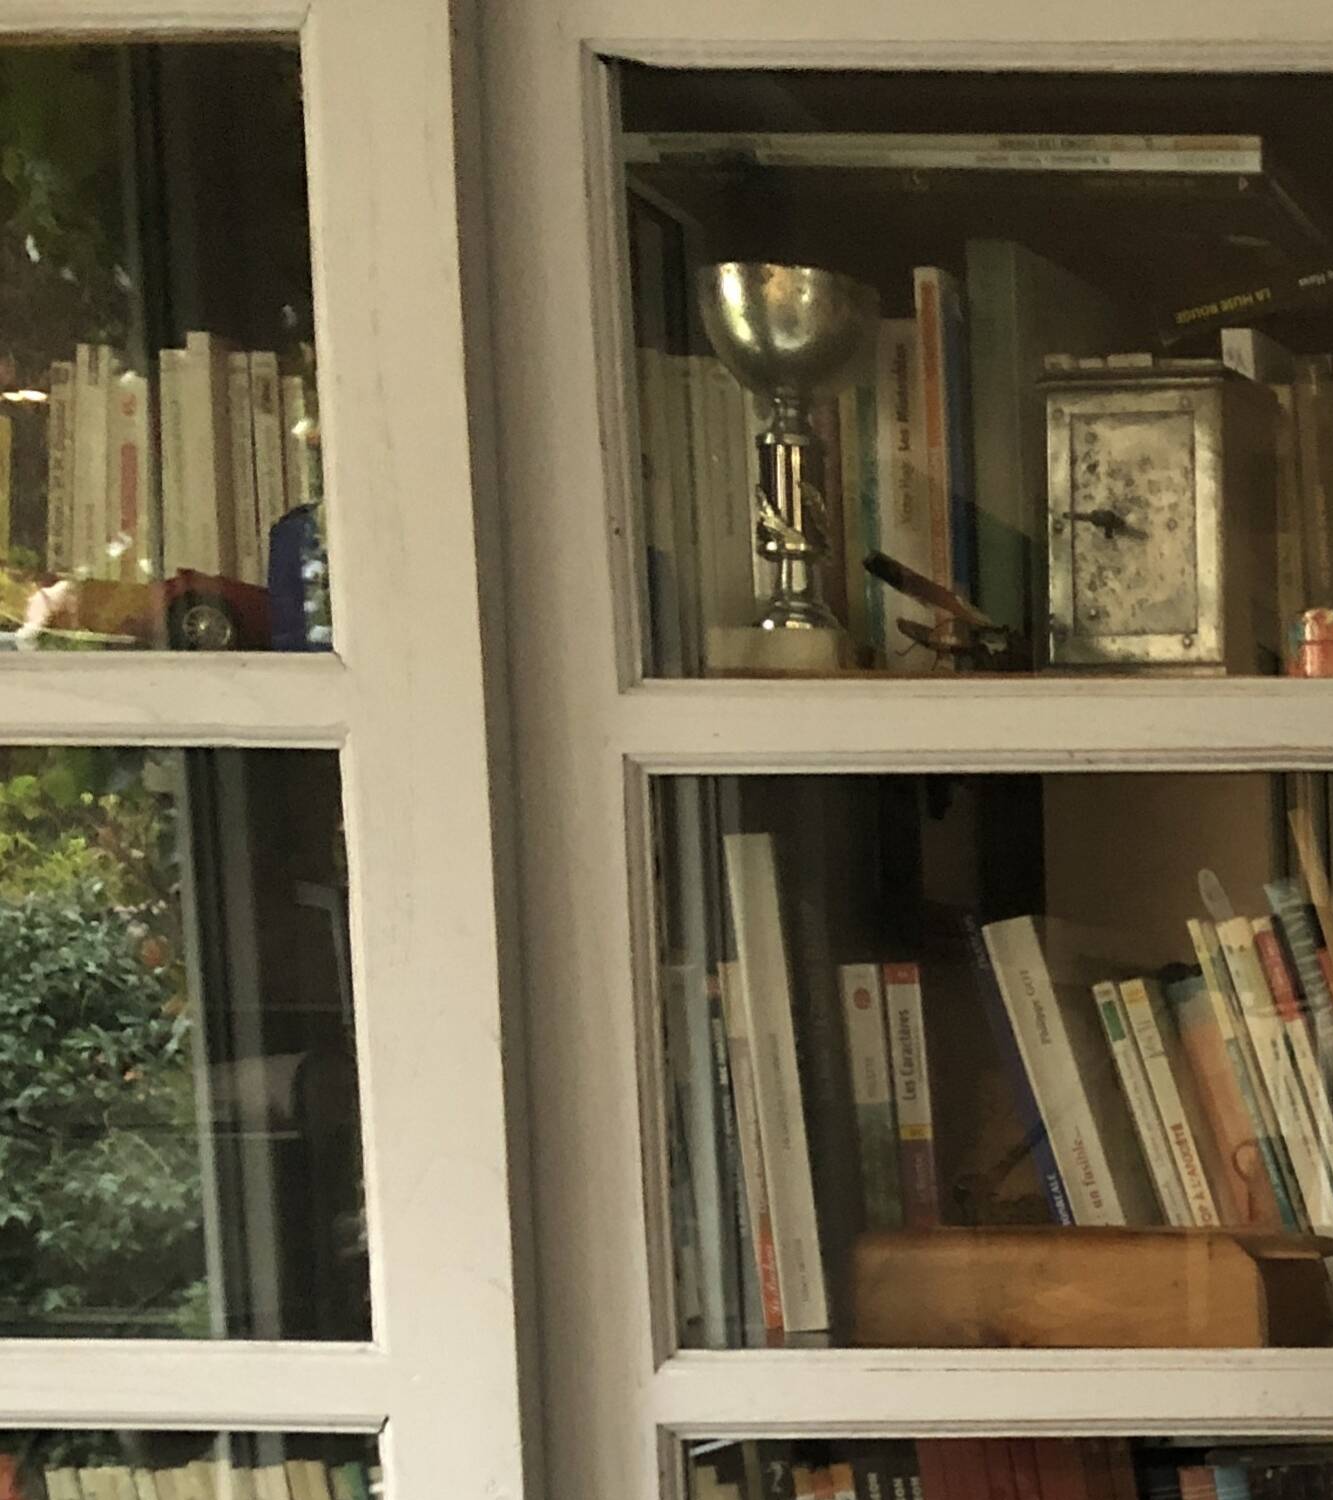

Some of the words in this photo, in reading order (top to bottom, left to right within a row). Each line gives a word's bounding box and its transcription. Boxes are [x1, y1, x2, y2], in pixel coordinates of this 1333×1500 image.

[1175, 301, 1219, 326] ROUGE
[895, 429, 911, 452] Les
[1026, 997, 1054, 1047] Philippe
[892, 1008, 918, 1076] Caractères
[899, 1079, 918, 1102] Les
[1083, 1188, 1103, 1211] un
